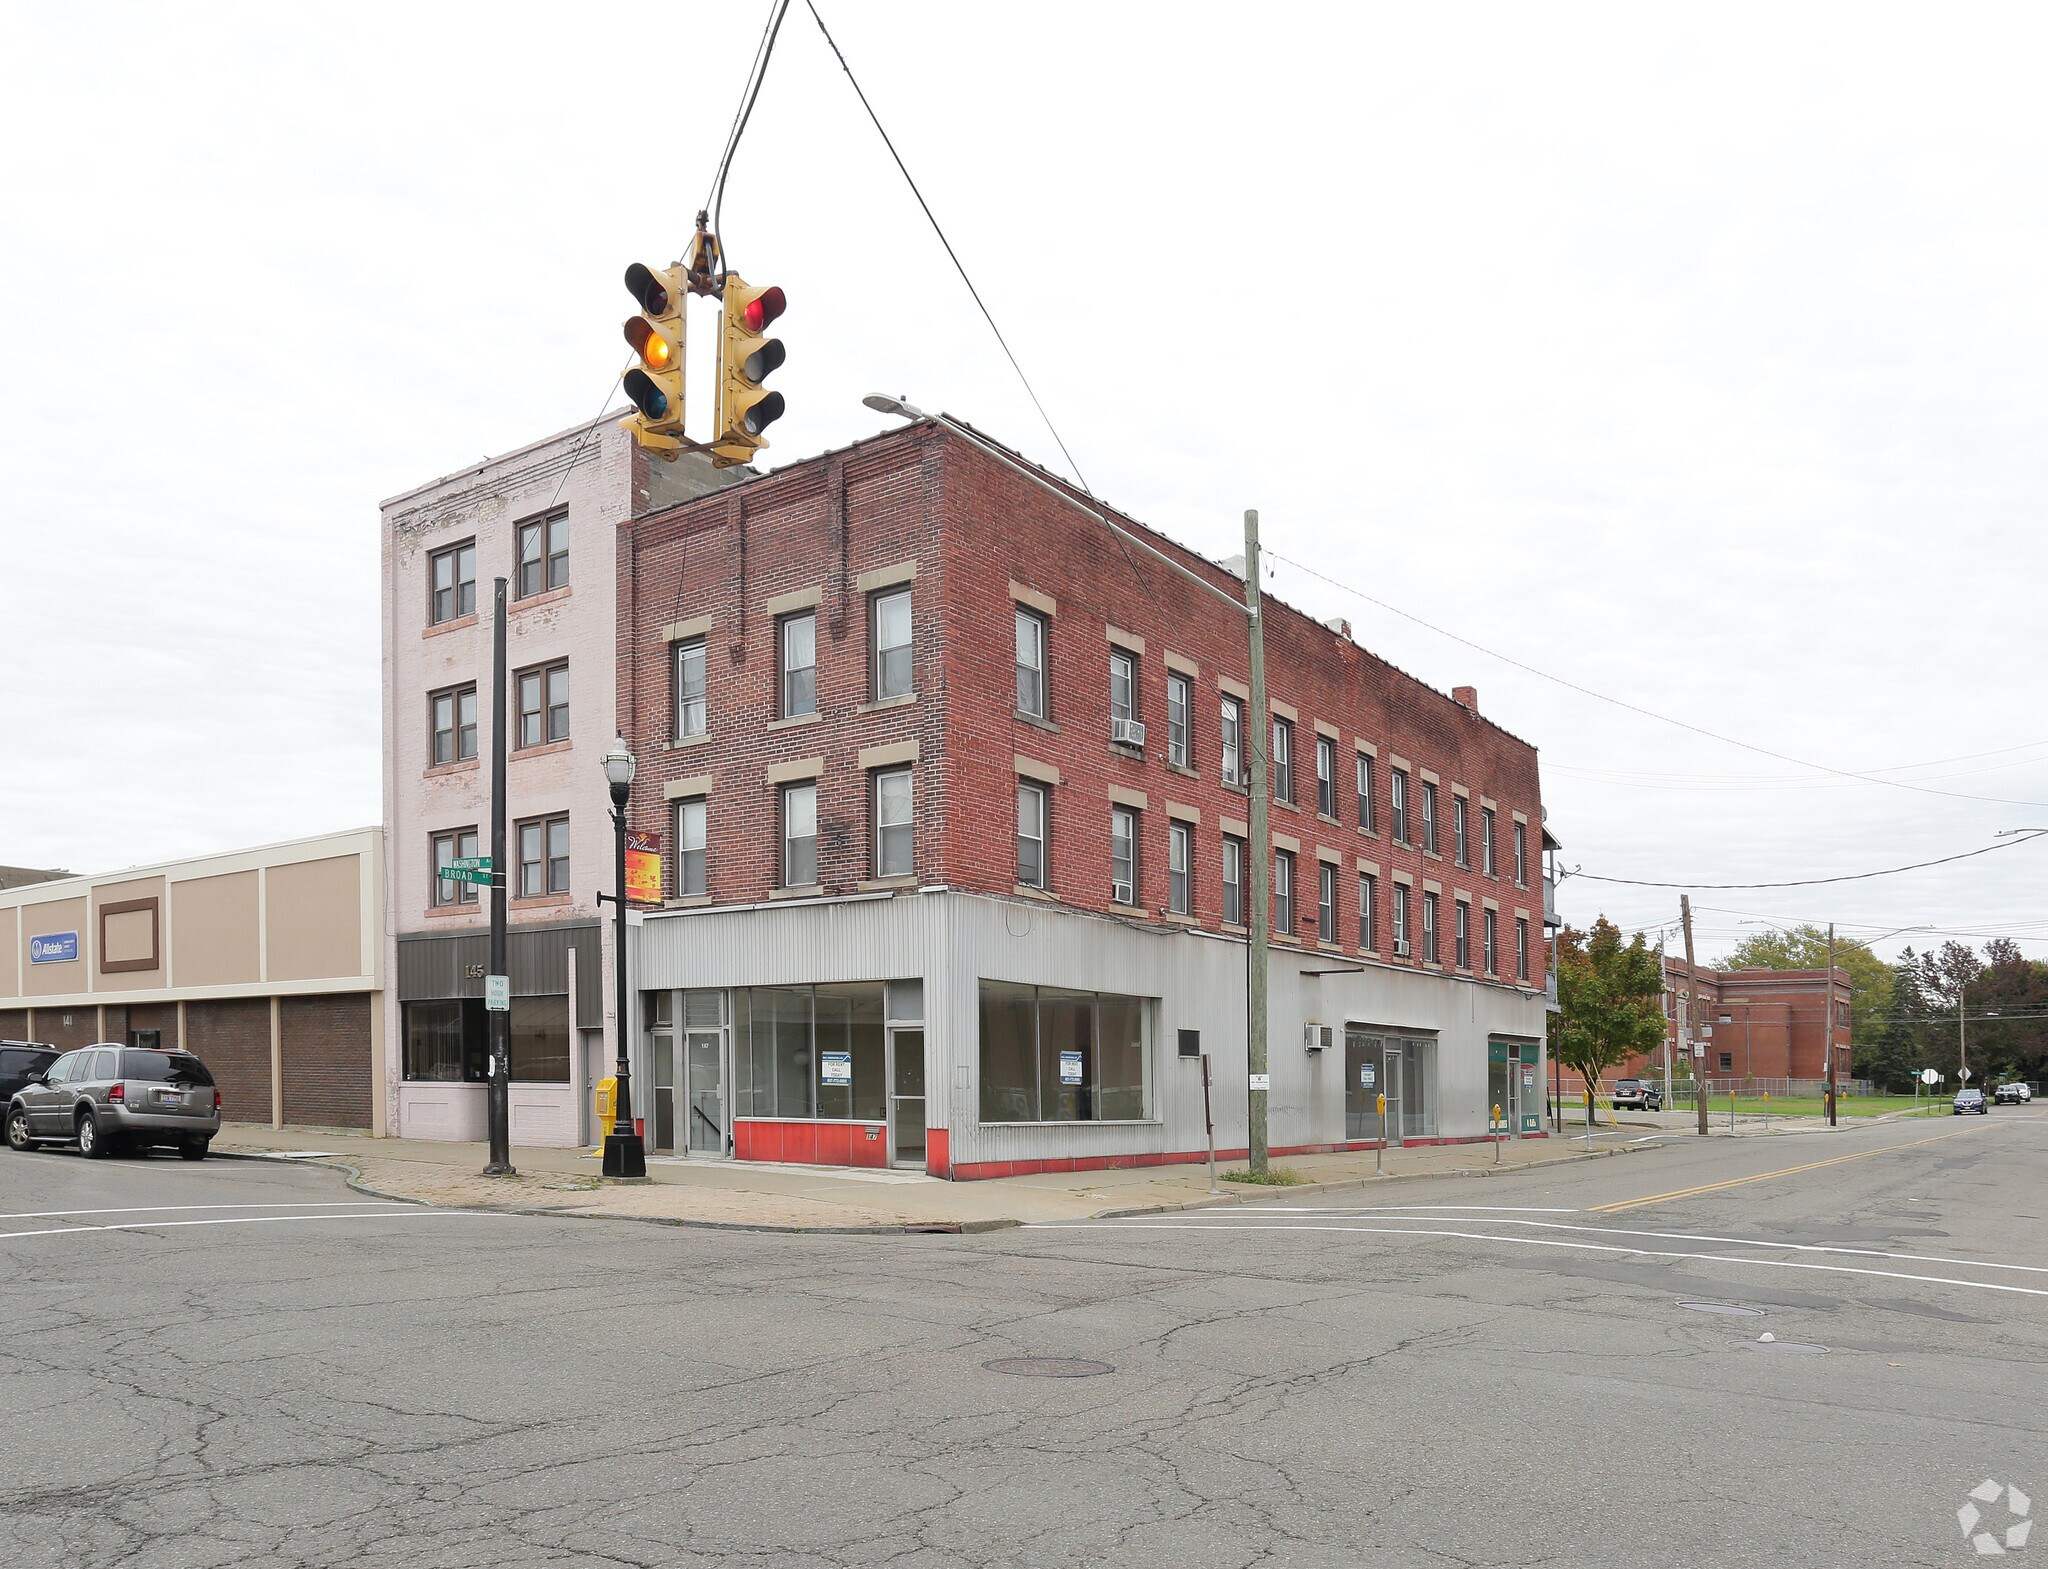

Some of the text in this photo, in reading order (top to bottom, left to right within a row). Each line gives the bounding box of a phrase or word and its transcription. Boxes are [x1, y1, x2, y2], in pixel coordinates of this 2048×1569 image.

[627, 835, 658, 853] Welcome
[452, 859, 480, 869] WASHINGTON
[444, 869, 473, 881] BROAD
[42, 942, 63, 955] Allstate
[465, 964, 484, 978] 145
